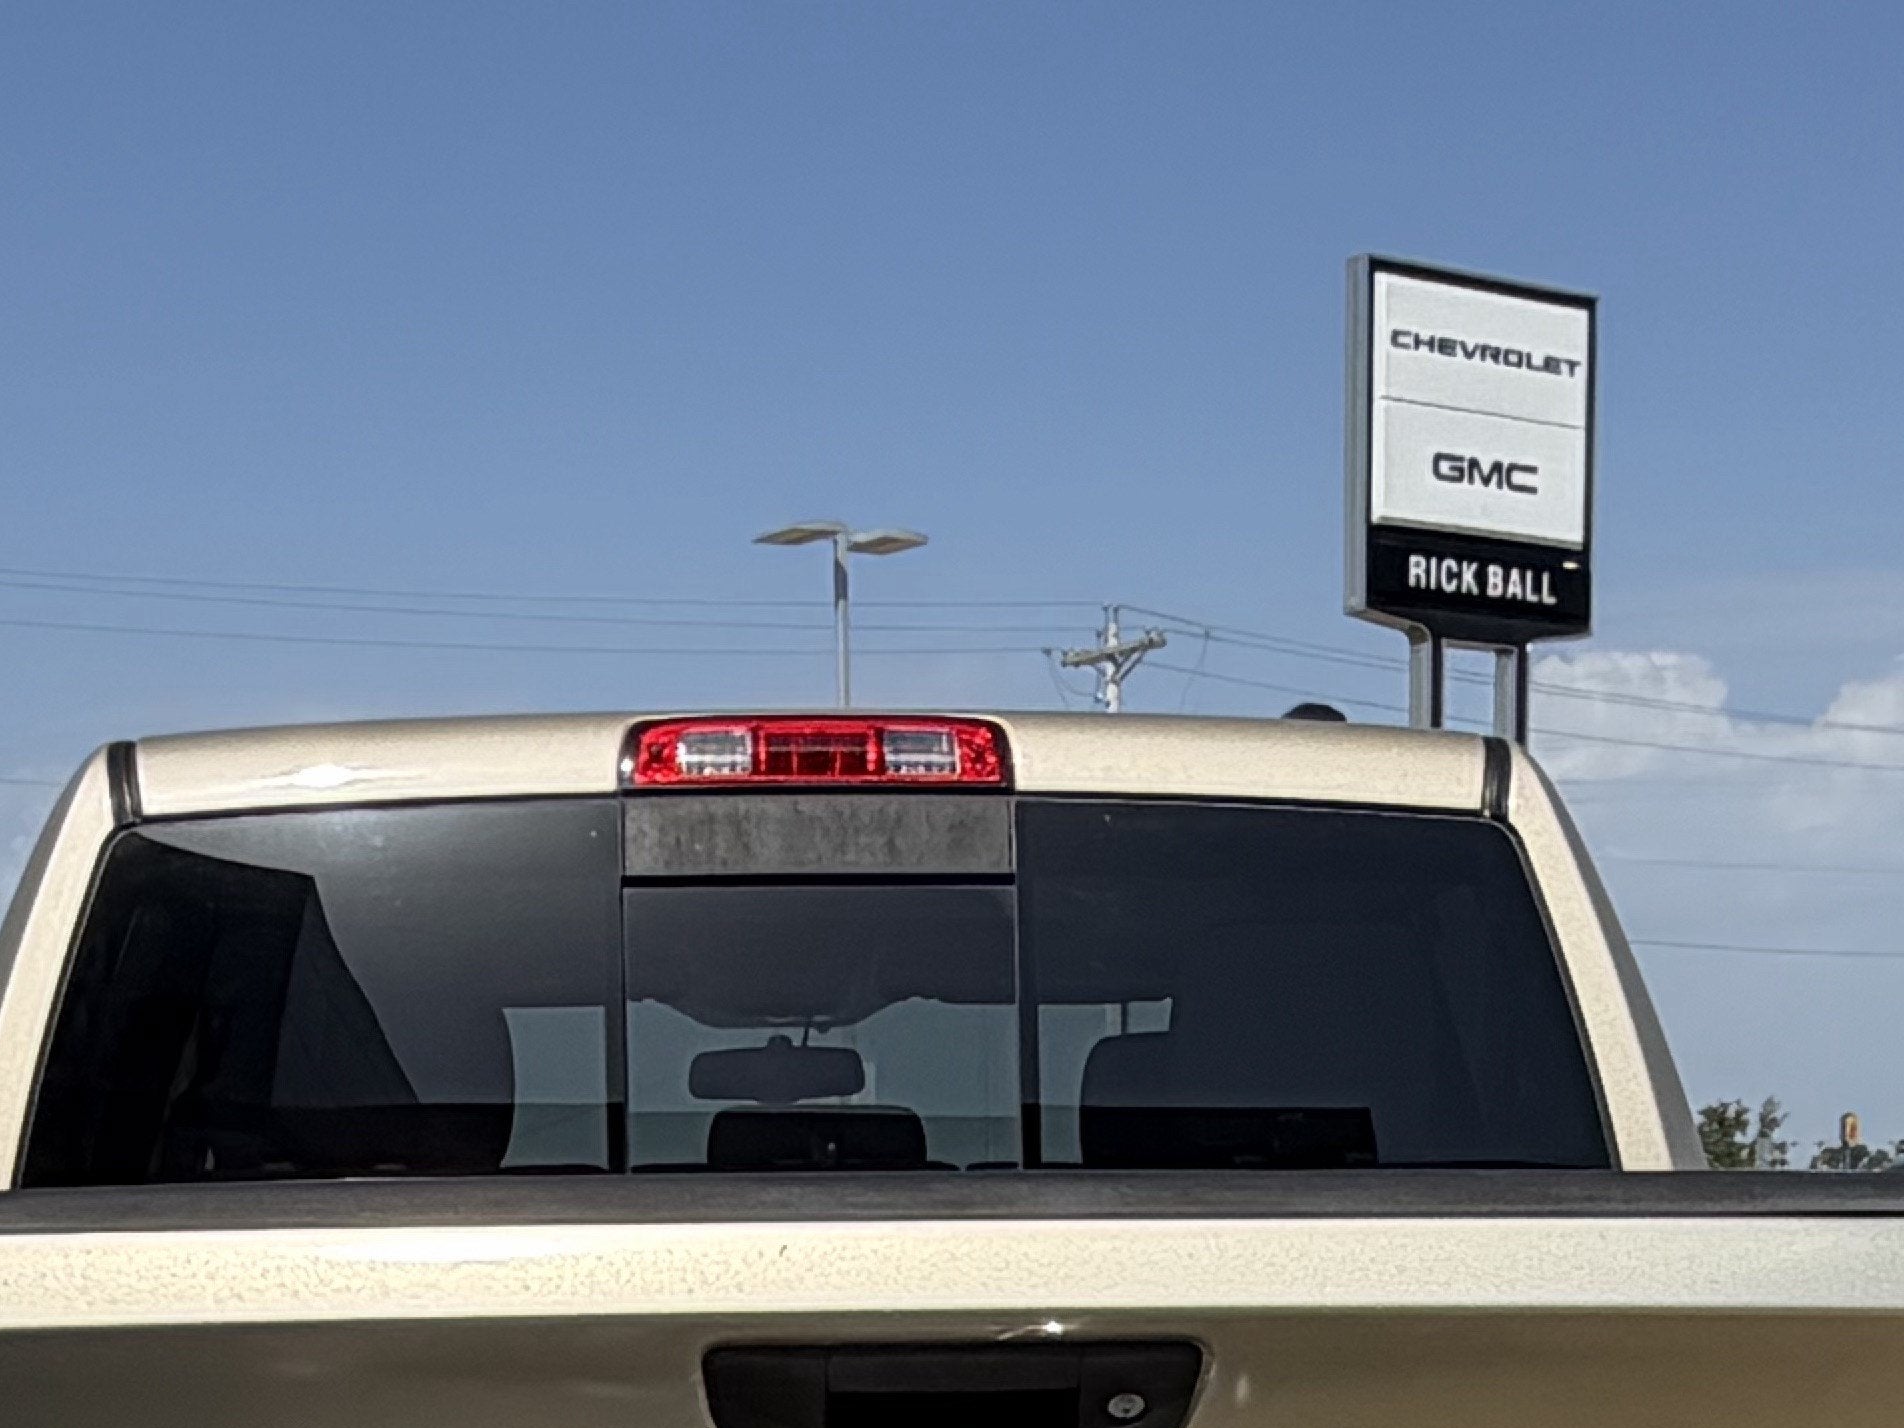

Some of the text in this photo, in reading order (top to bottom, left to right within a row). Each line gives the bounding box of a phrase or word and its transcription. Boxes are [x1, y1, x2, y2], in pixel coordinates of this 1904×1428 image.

[1390, 328, 1582, 378] CHEVROLET
[1431, 451, 1539, 496] GMC
[1407, 553, 1558, 606] RICK BALL
